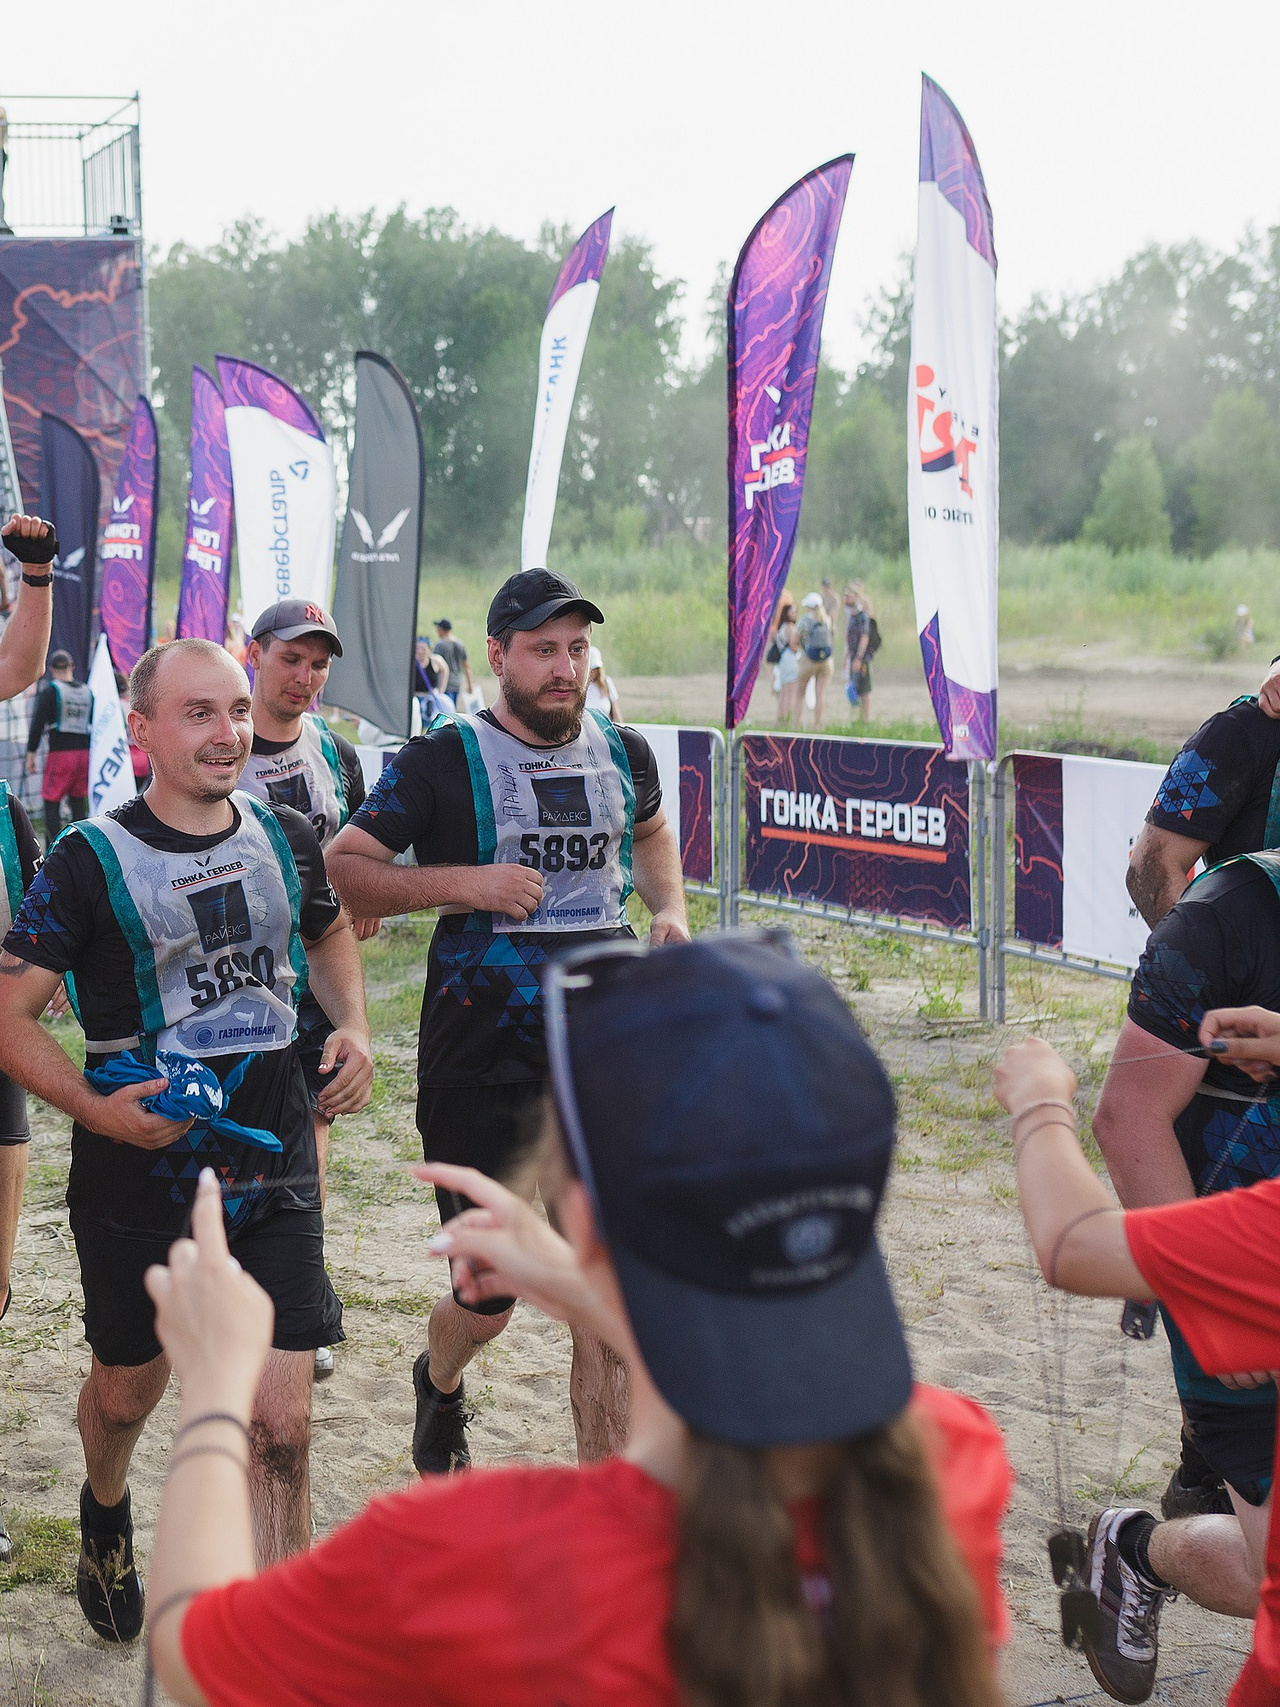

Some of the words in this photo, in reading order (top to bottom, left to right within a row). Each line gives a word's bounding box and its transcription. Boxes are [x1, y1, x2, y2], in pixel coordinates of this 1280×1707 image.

[255, 768, 279, 777] ГОНКА
[518, 761, 551, 771] ГОНКА
[542, 810, 588, 822] РАЙДЕКС
[760, 788, 839, 833] ГОНКА
[845, 798, 947, 847] ГЕРОЕВ
[520, 832, 610, 873] 5893
[171, 872, 207, 888] ГОНКА
[206, 860, 244, 877] ГЕРОЕВ
[547, 907, 601, 918] ГАЗПРОМБАНК
[205, 923, 247, 945] РАЙЕКС
[219, 1025, 277, 1039] ГАЗПРОМБАНК
